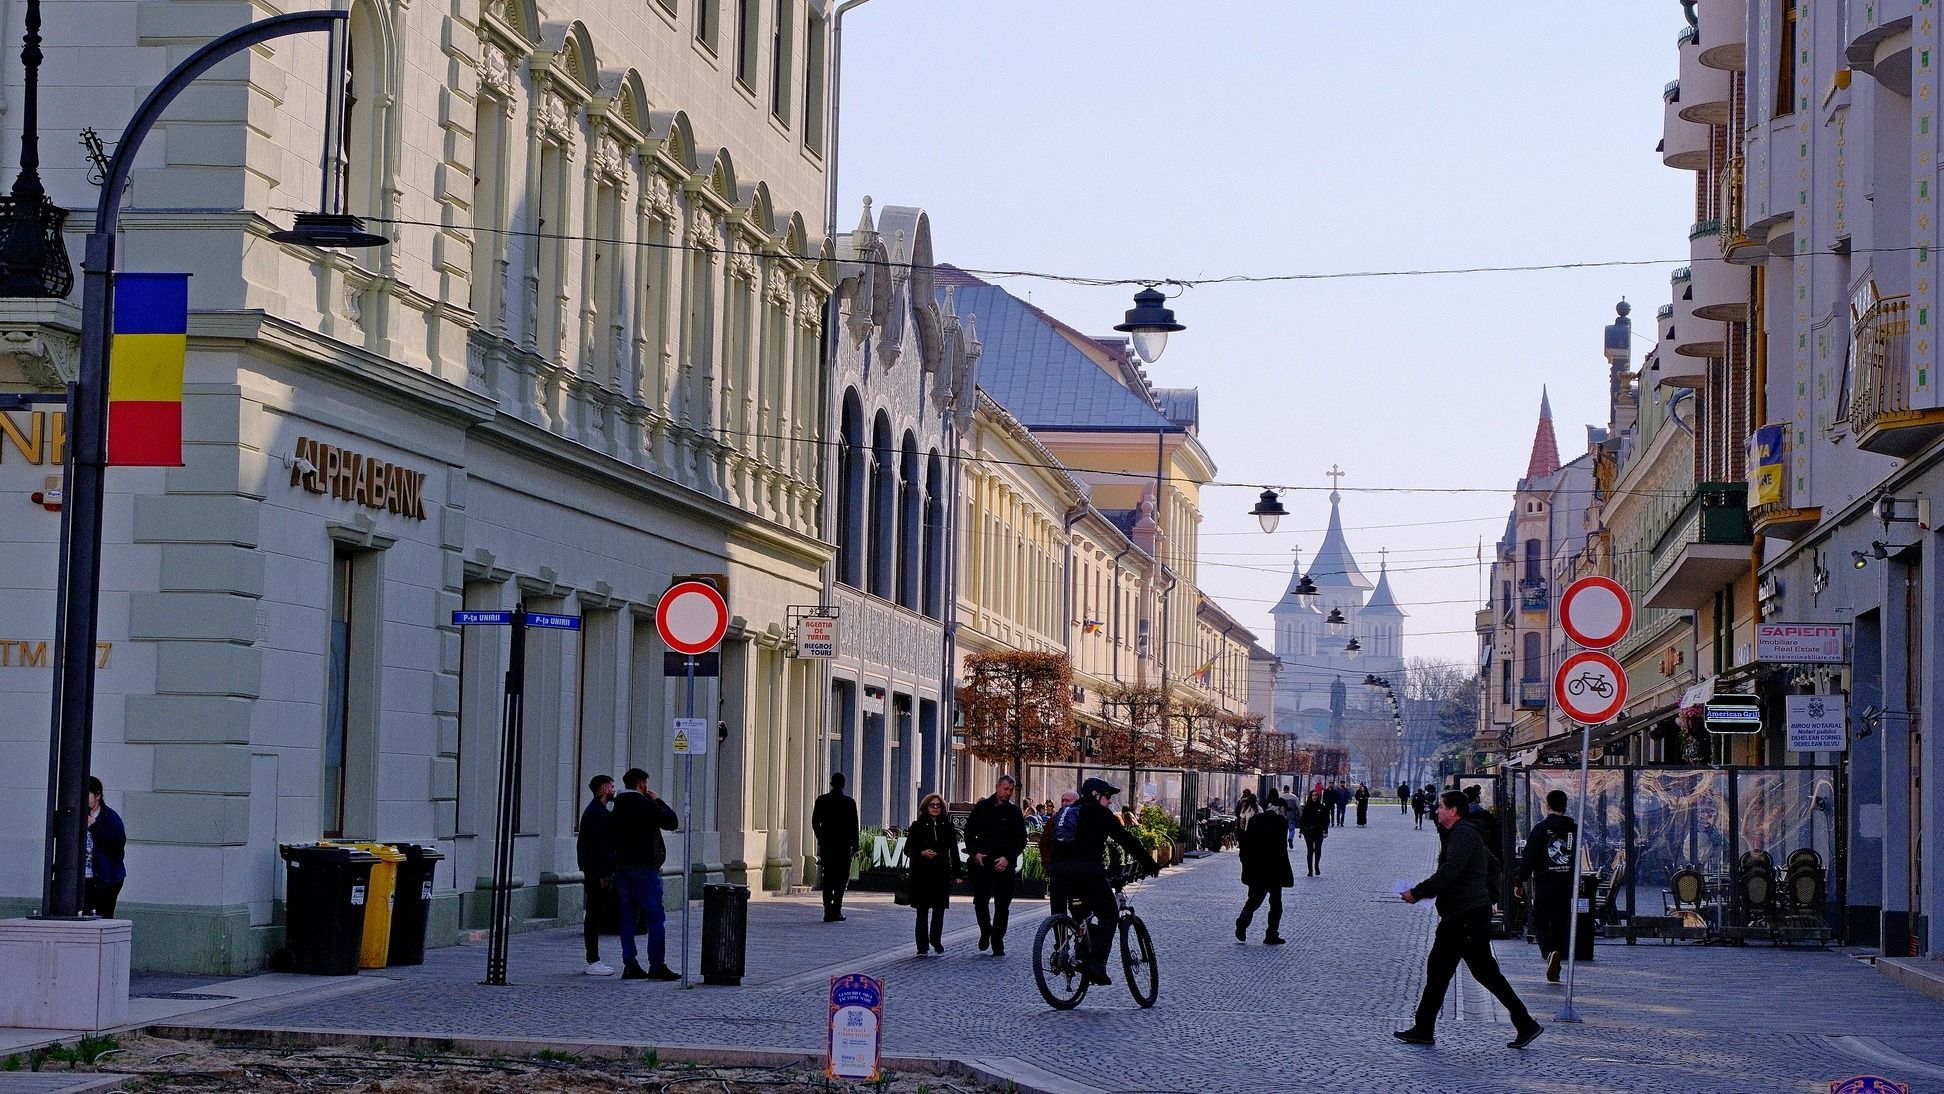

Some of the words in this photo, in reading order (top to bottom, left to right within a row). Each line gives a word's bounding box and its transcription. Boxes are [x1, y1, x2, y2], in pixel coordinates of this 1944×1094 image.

[290, 436, 367, 504] ALPHA
[366, 457, 427, 520] BANK
[550, 617, 571, 626] UNIRII
[1761, 627, 1840, 637] SAPIENT
